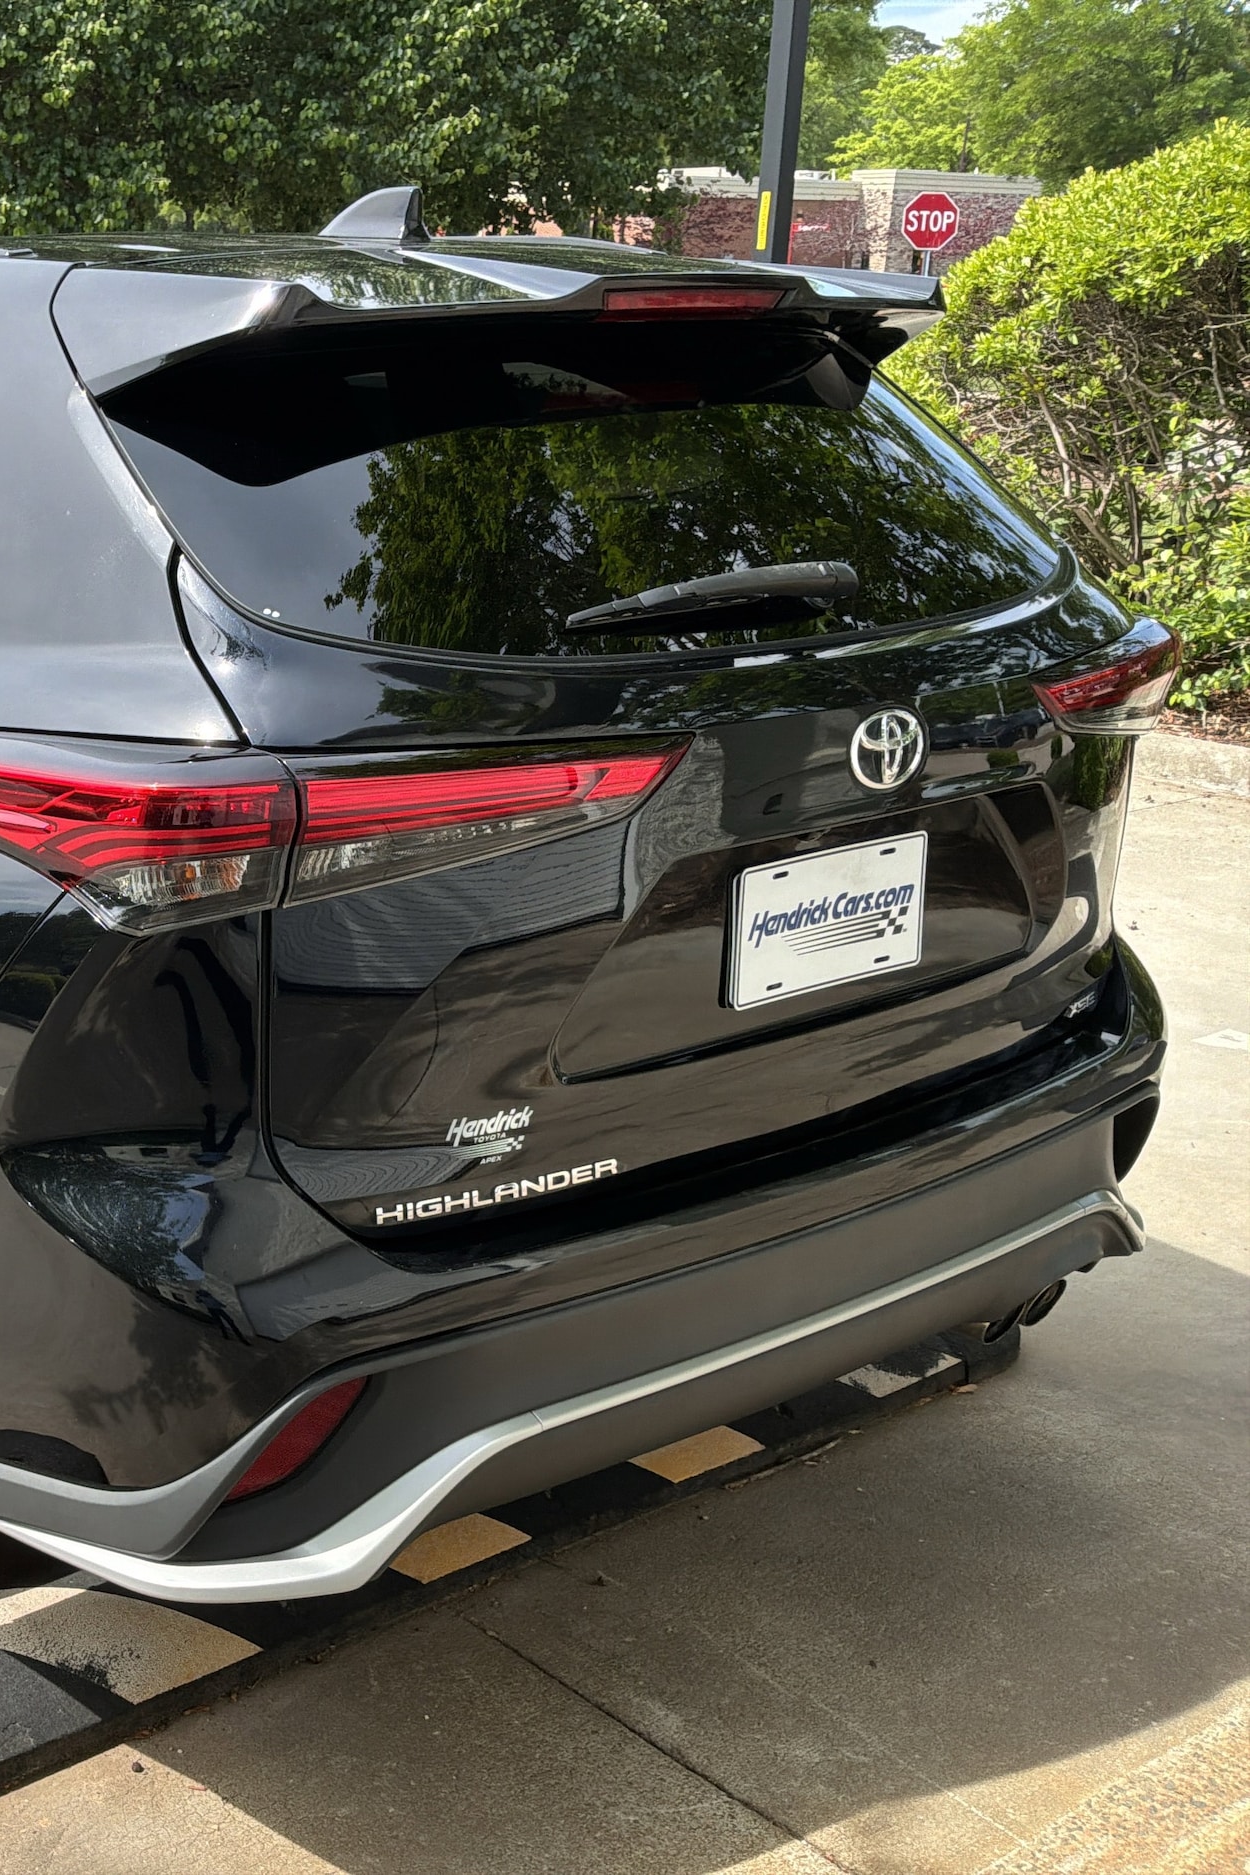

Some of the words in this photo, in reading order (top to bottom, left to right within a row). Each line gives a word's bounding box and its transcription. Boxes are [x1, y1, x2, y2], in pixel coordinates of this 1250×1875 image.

[906, 210, 955, 232] STOP
[445, 1105, 534, 1147] Hendrick
[473, 1132, 507, 1144] TOYOTA
[479, 1155, 503, 1165] APEX
[375, 1158, 618, 1225] HIGHLANDER
